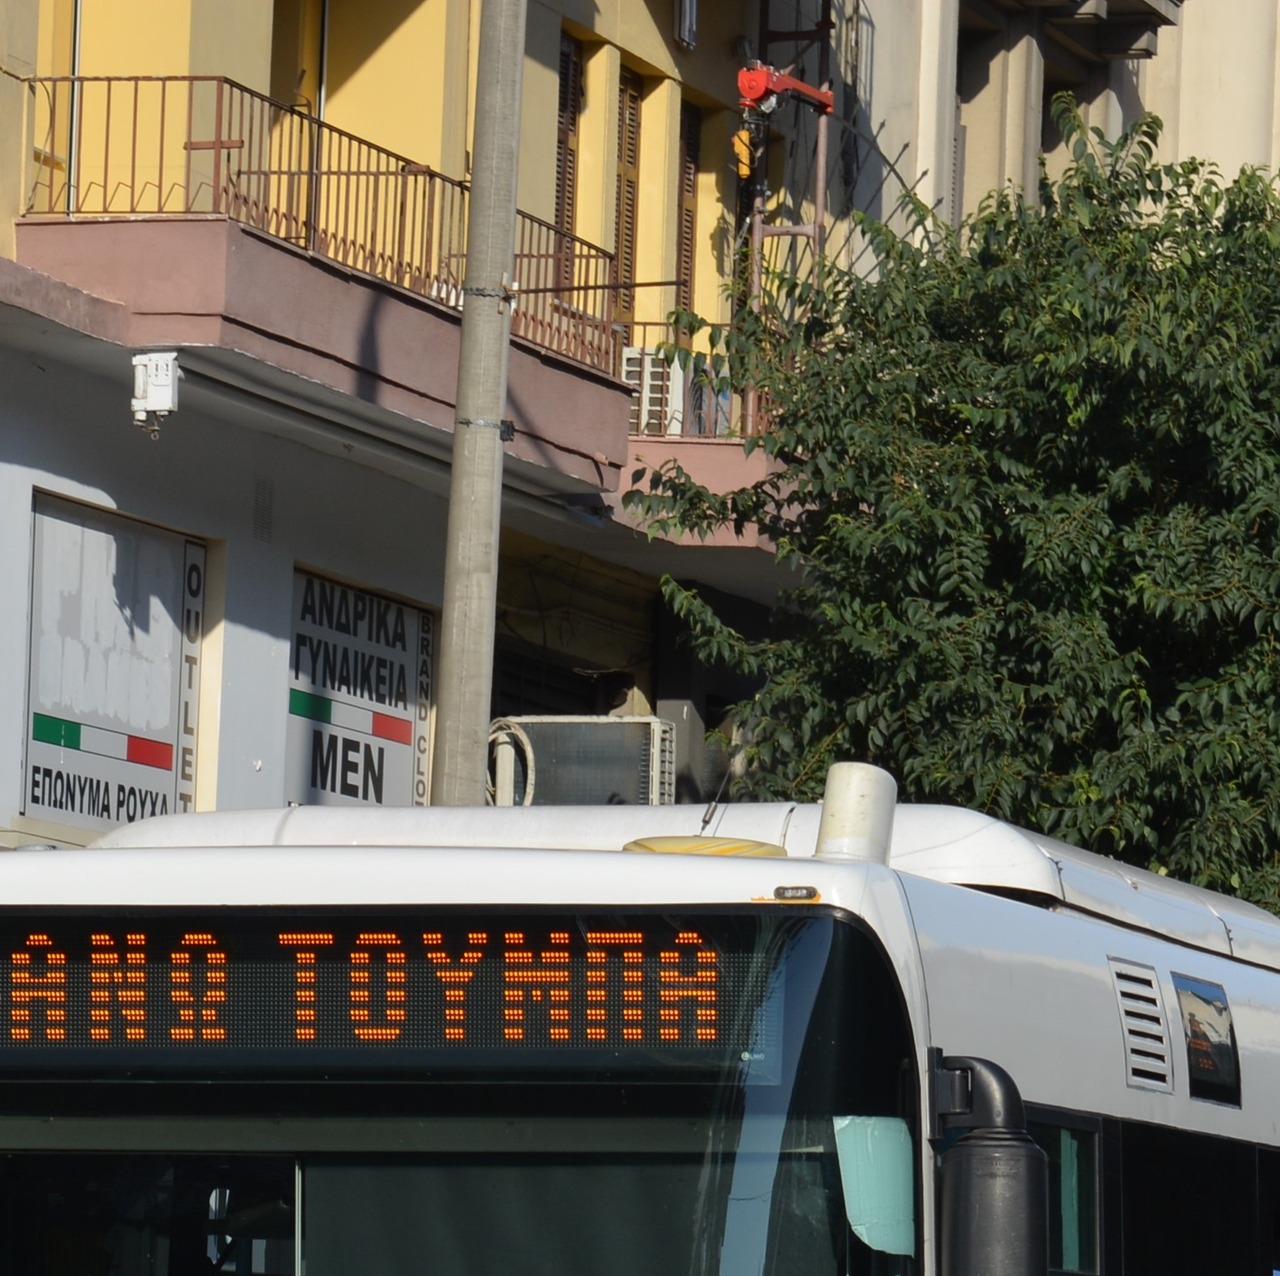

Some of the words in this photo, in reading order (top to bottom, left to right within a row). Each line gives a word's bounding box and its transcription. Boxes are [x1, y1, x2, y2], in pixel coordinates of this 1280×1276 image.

[300, 577, 408, 652] ΑΝΔΡΙΚΑ
[295, 632, 408, 711] ΓΥΝΑΙΚΕΙΑ
[31, 765, 111, 820] ΕΠΩΝΥΜΑ
[311, 728, 385, 804] MEN
[415, 735, 427, 806] CLO
[11, 933, 226, 1040] ΑΝΩ
[278, 932, 717, 1040] ΤΟΥΜΠΑ
